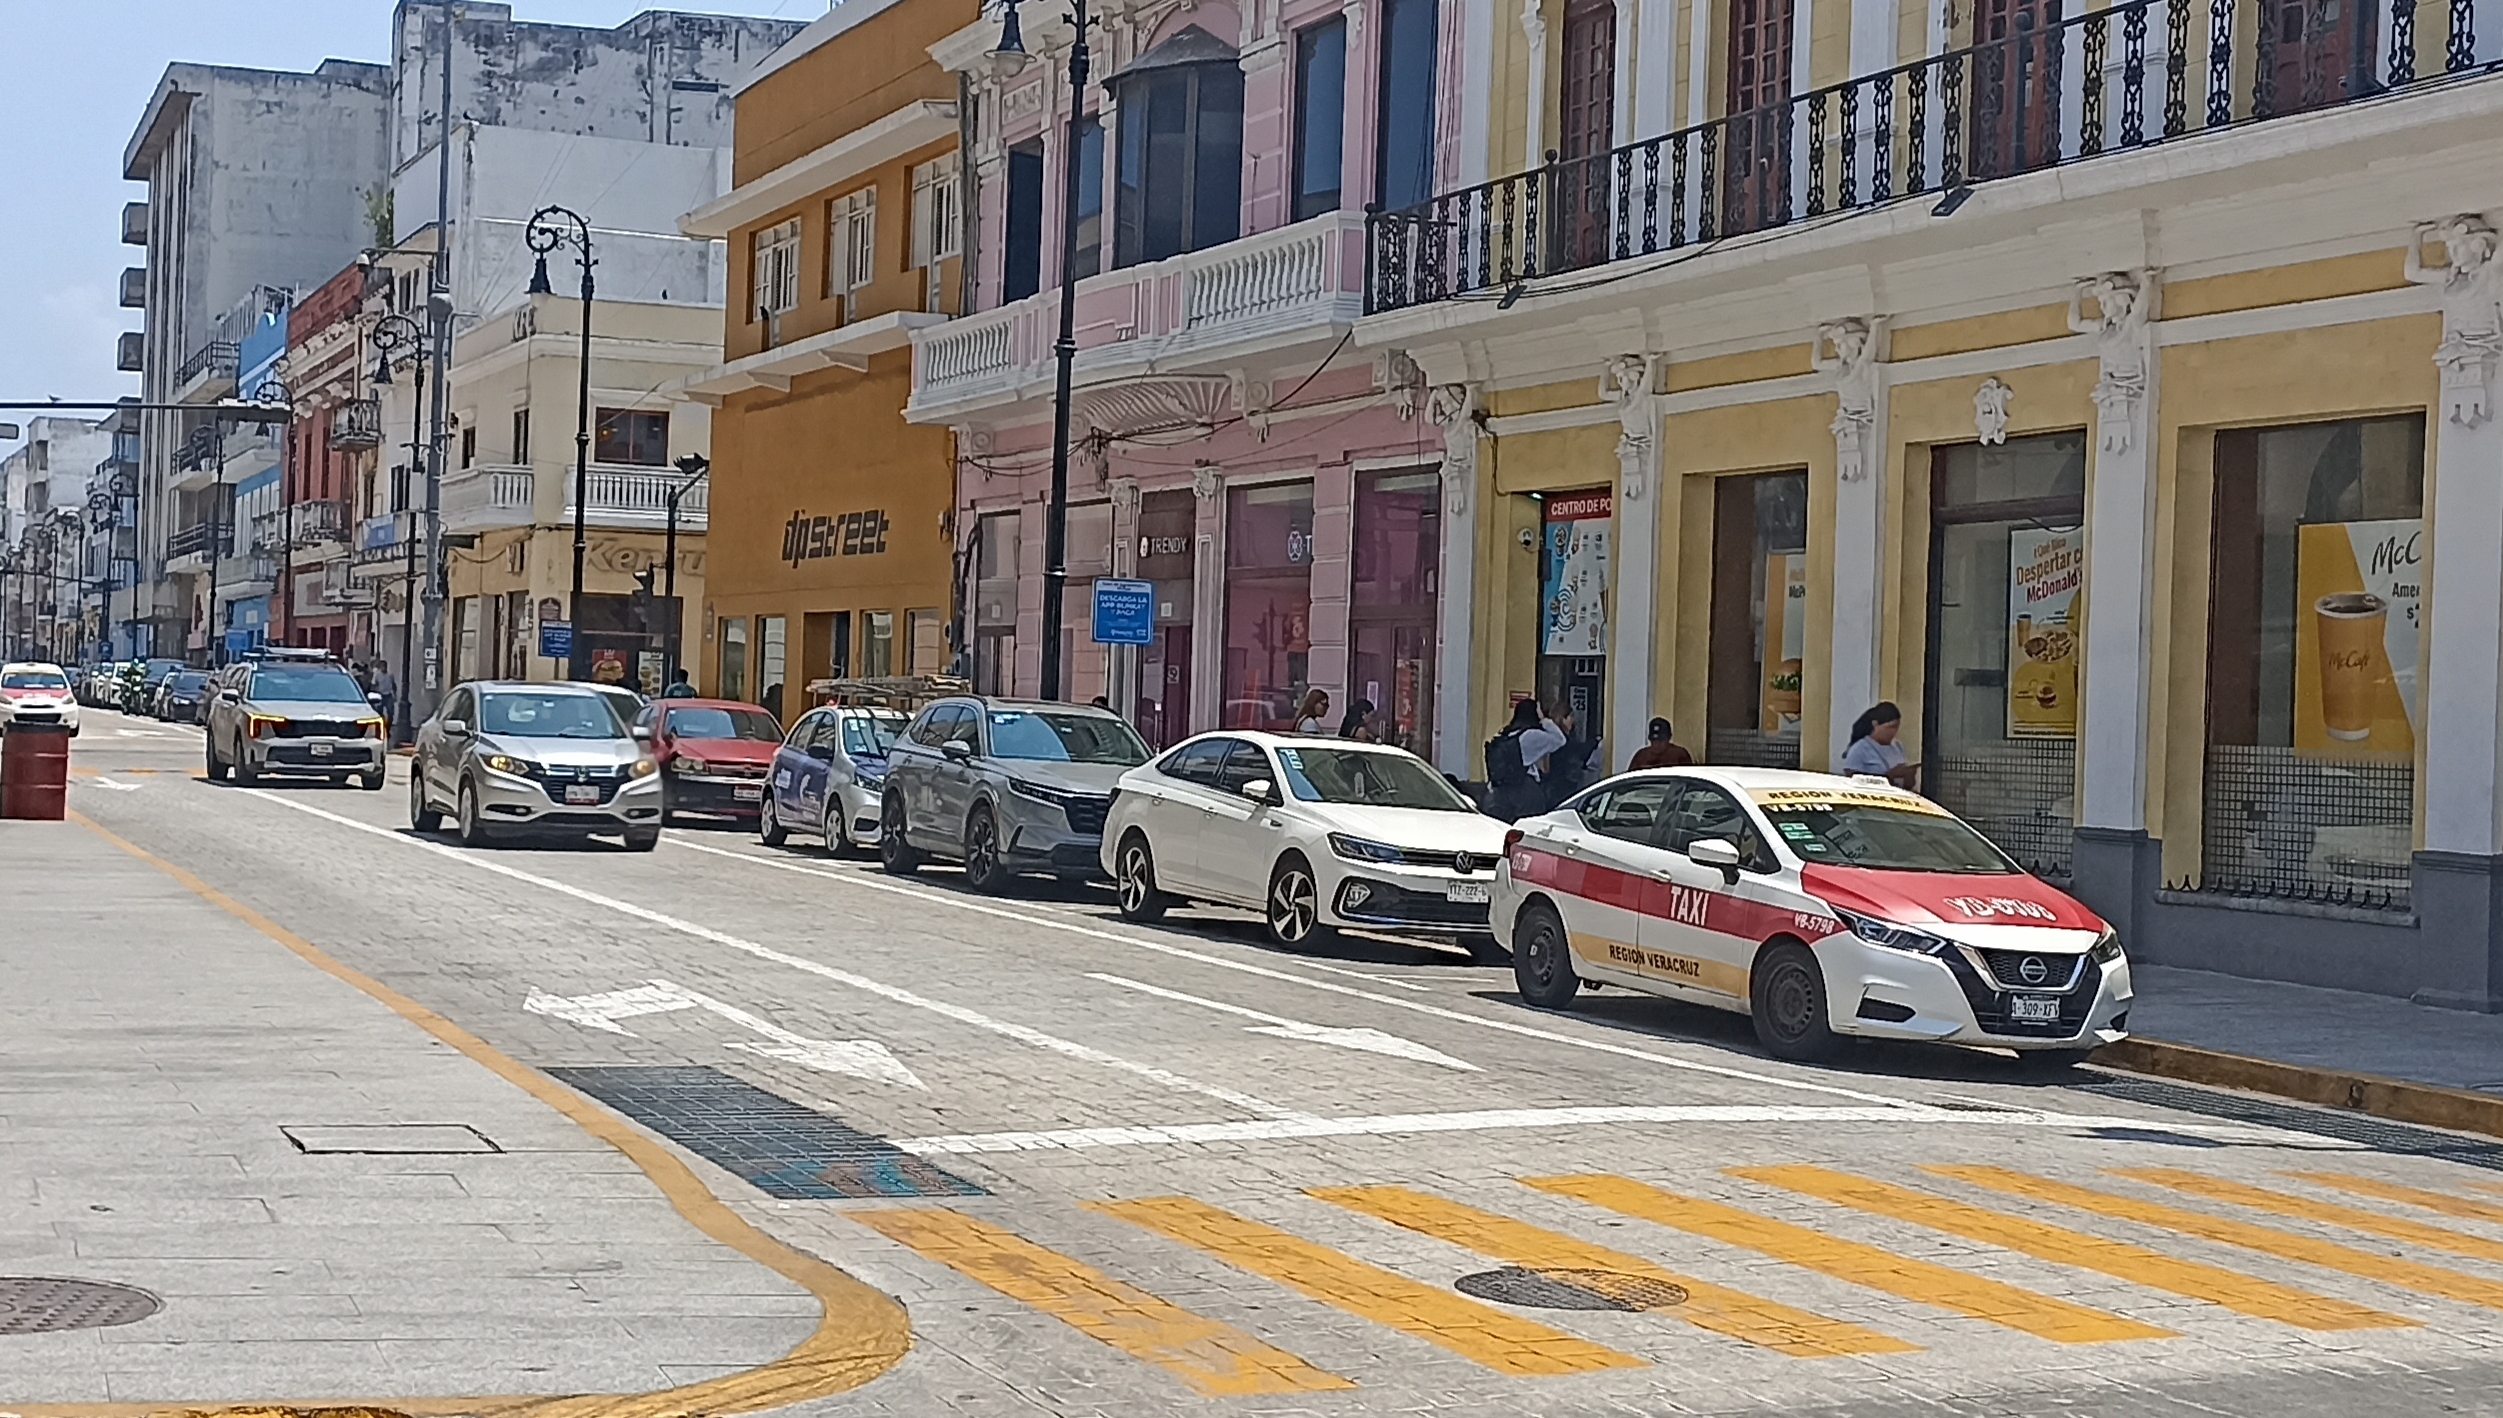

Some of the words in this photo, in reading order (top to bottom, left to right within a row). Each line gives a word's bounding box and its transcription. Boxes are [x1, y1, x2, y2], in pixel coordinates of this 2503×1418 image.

[1551, 500, 1586, 516] CENTRO
[1587, 499, 1599, 513] DE
[1151, 536, 1188, 554] TRENDY
[2017, 551, 2072, 586] Despertar
[1100, 594, 1137, 603] DESCARGA
[1138, 596, 1147, 604] LA
[1768, 791, 1832, 800] REGION
[1839, 791, 1922, 807] VERACRUZ
[1670, 887, 1711, 926] TAXI
[1795, 913, 1835, 934] VB-5798
[1609, 944, 1646, 966] REGION
[1647, 952, 1700, 977] VERACRUZ
